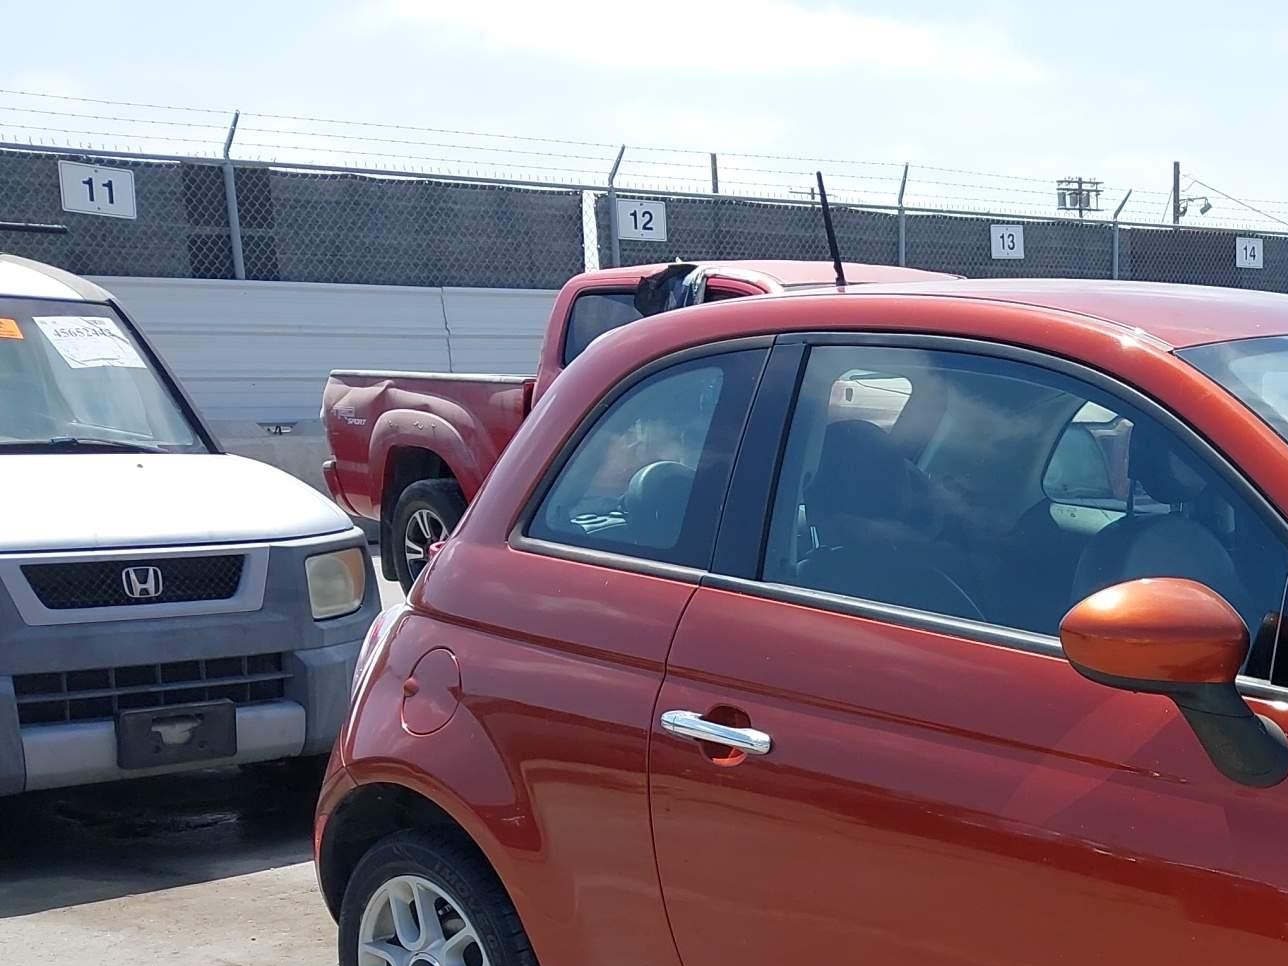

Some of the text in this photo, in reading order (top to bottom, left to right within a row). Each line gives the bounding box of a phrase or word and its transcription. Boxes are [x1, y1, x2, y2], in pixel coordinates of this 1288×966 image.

[82, 177, 114, 204] 11
[630, 210, 653, 230] 12
[1000, 233, 1015, 250] 13
[1243, 245, 1256, 260] 14
